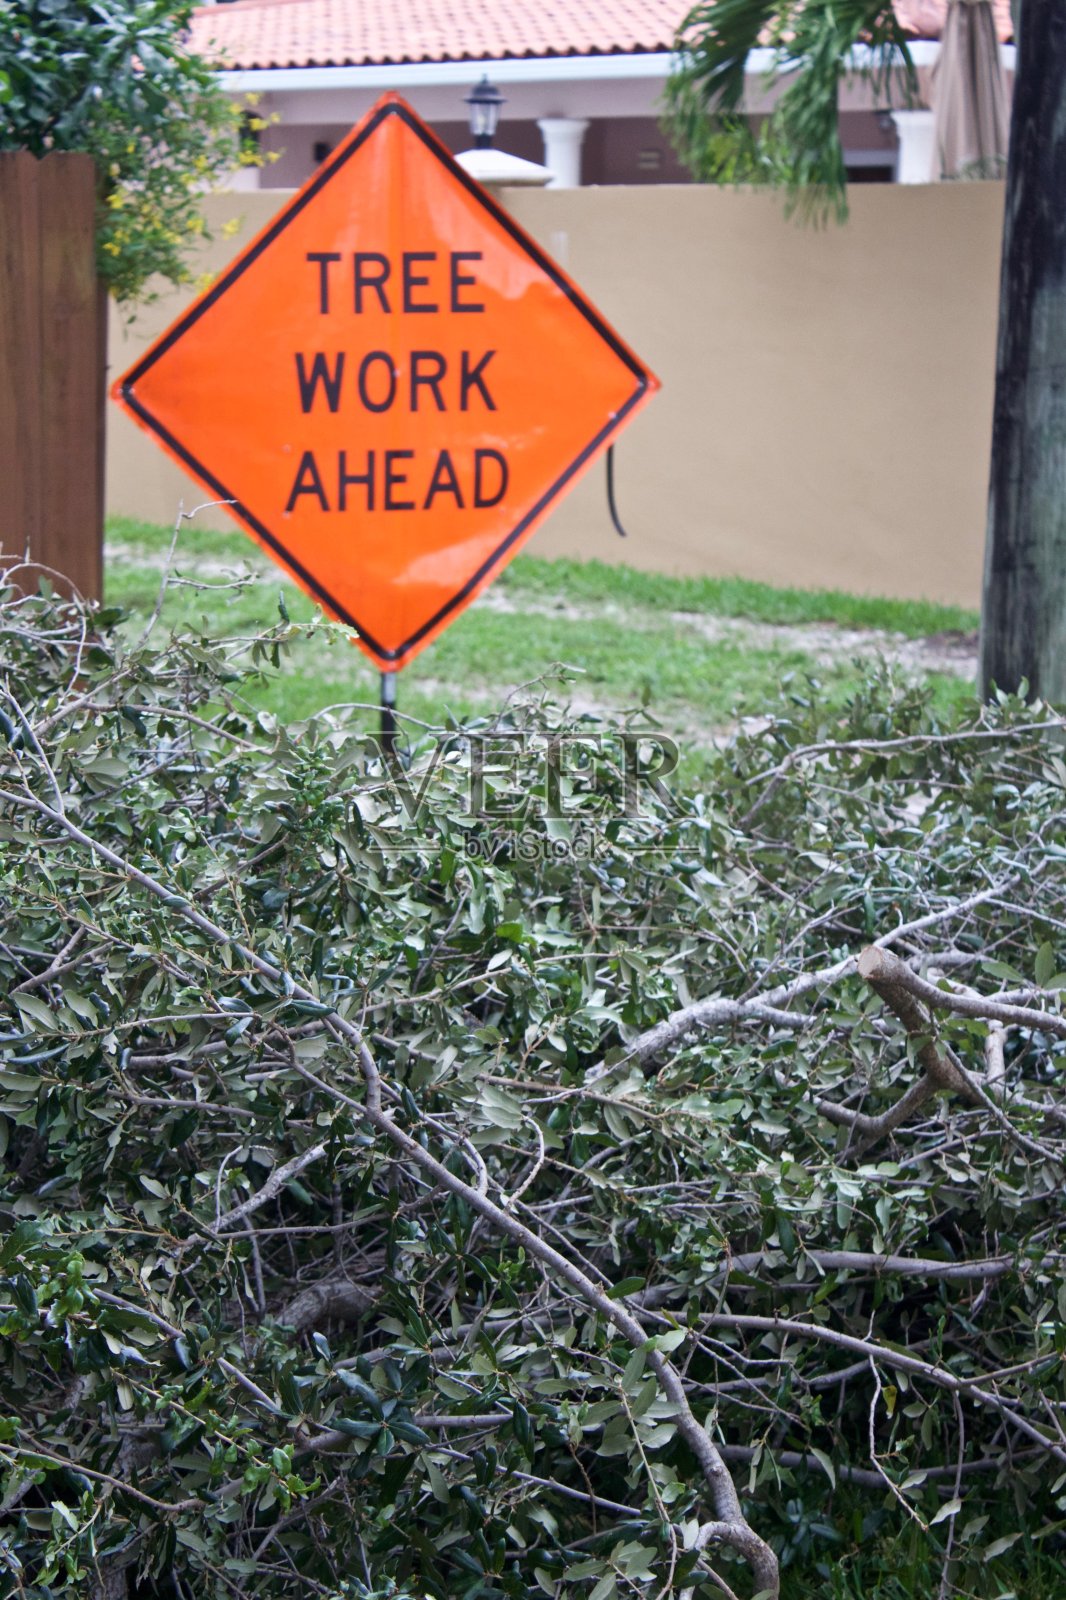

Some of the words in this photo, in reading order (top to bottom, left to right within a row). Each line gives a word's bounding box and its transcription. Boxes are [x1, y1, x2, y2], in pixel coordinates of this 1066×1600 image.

[306, 251, 486, 314] TREE
[295, 350, 498, 413] WORK
[286, 448, 510, 512] AHEAD
